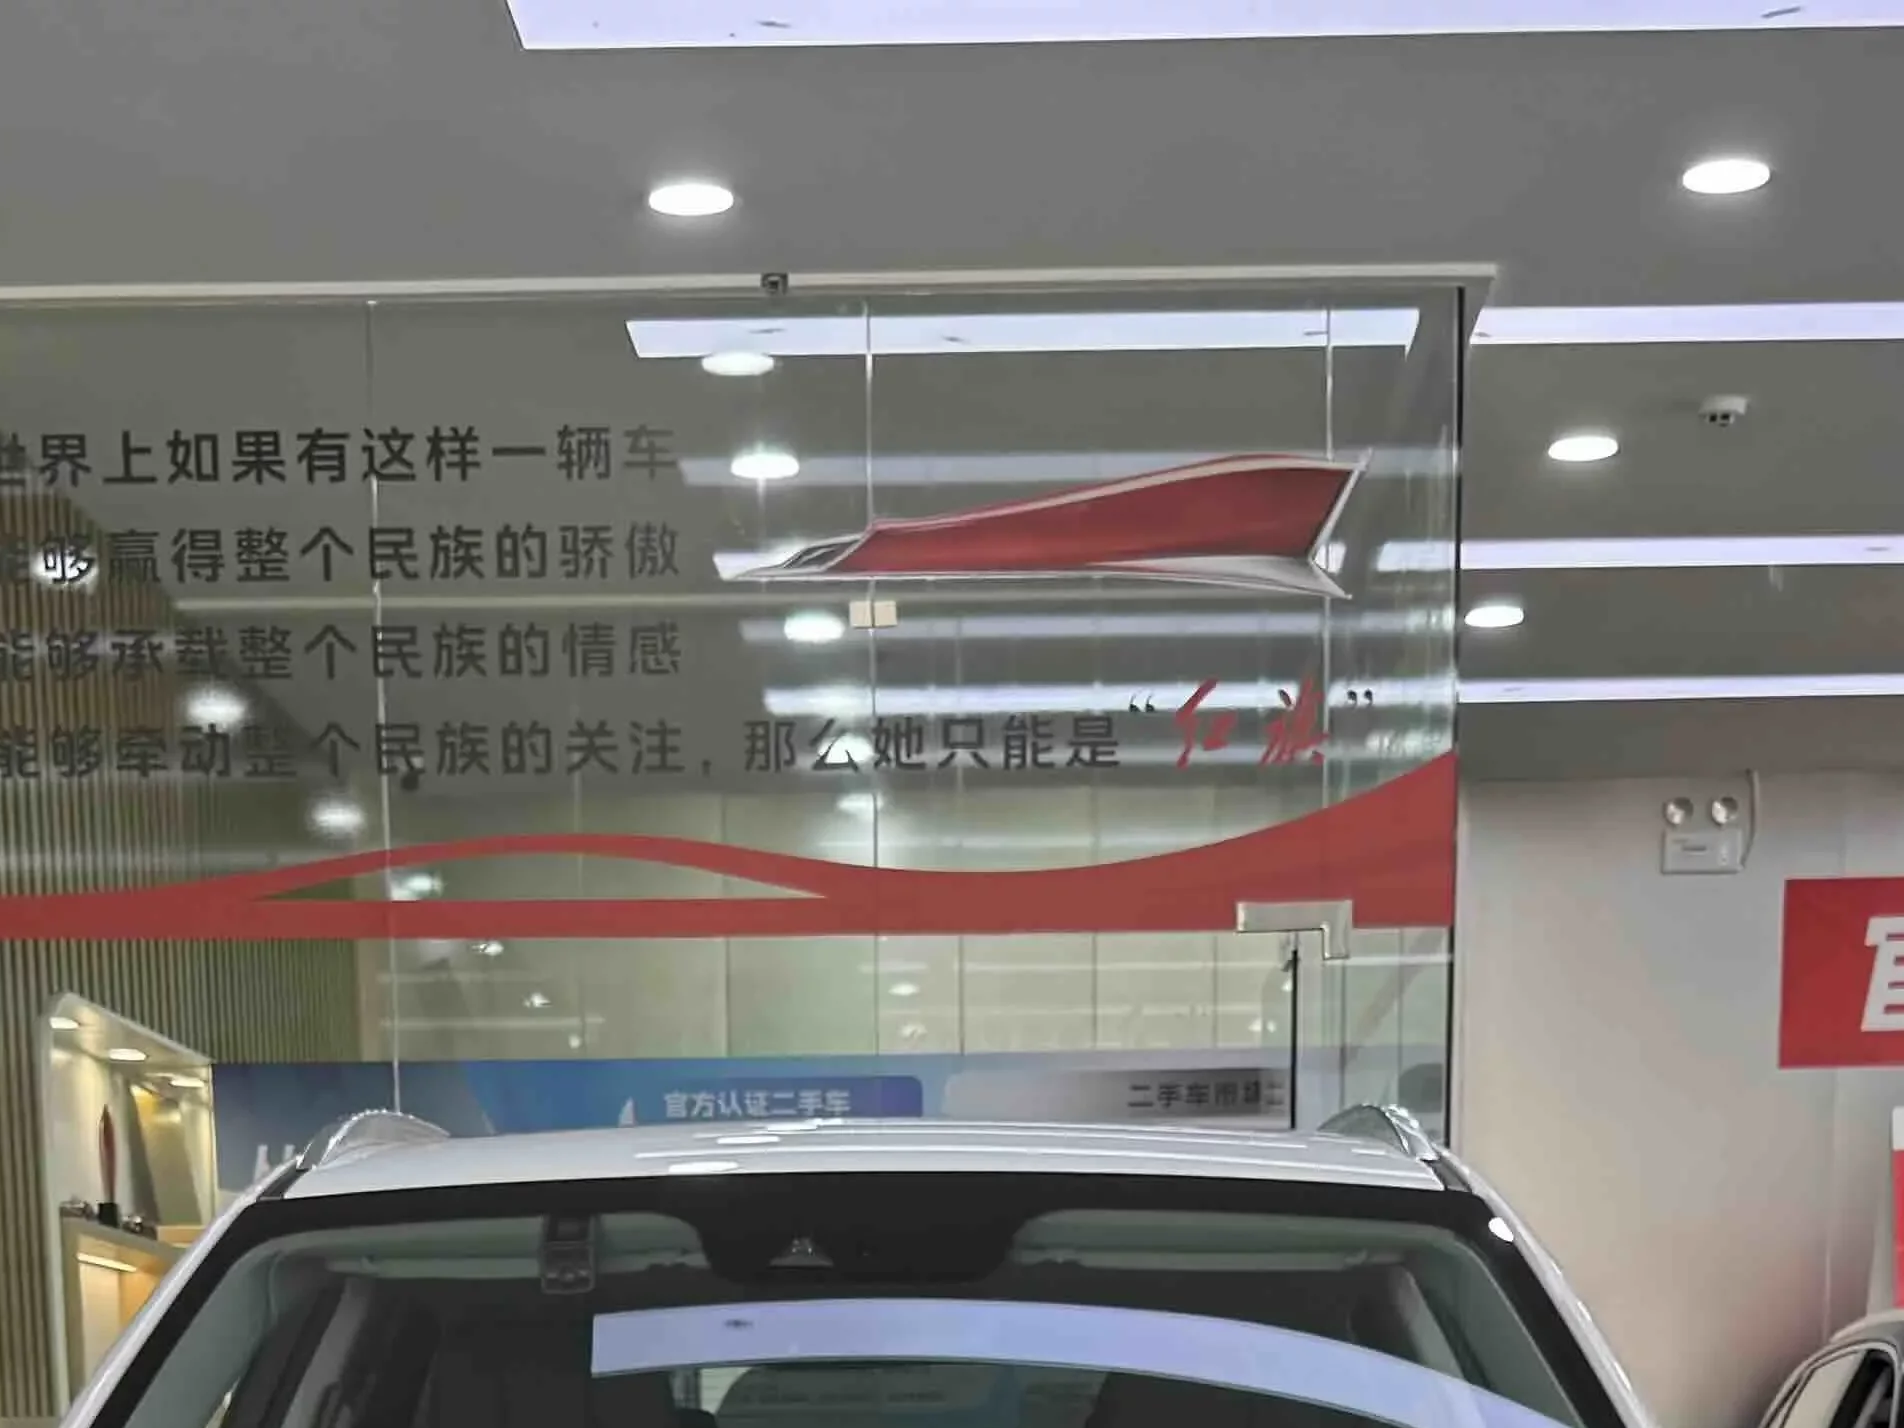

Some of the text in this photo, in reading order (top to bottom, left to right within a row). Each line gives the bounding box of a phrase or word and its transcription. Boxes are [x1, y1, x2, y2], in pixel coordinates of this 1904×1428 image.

[664, 1090, 851, 1118] 官方认证二手车
